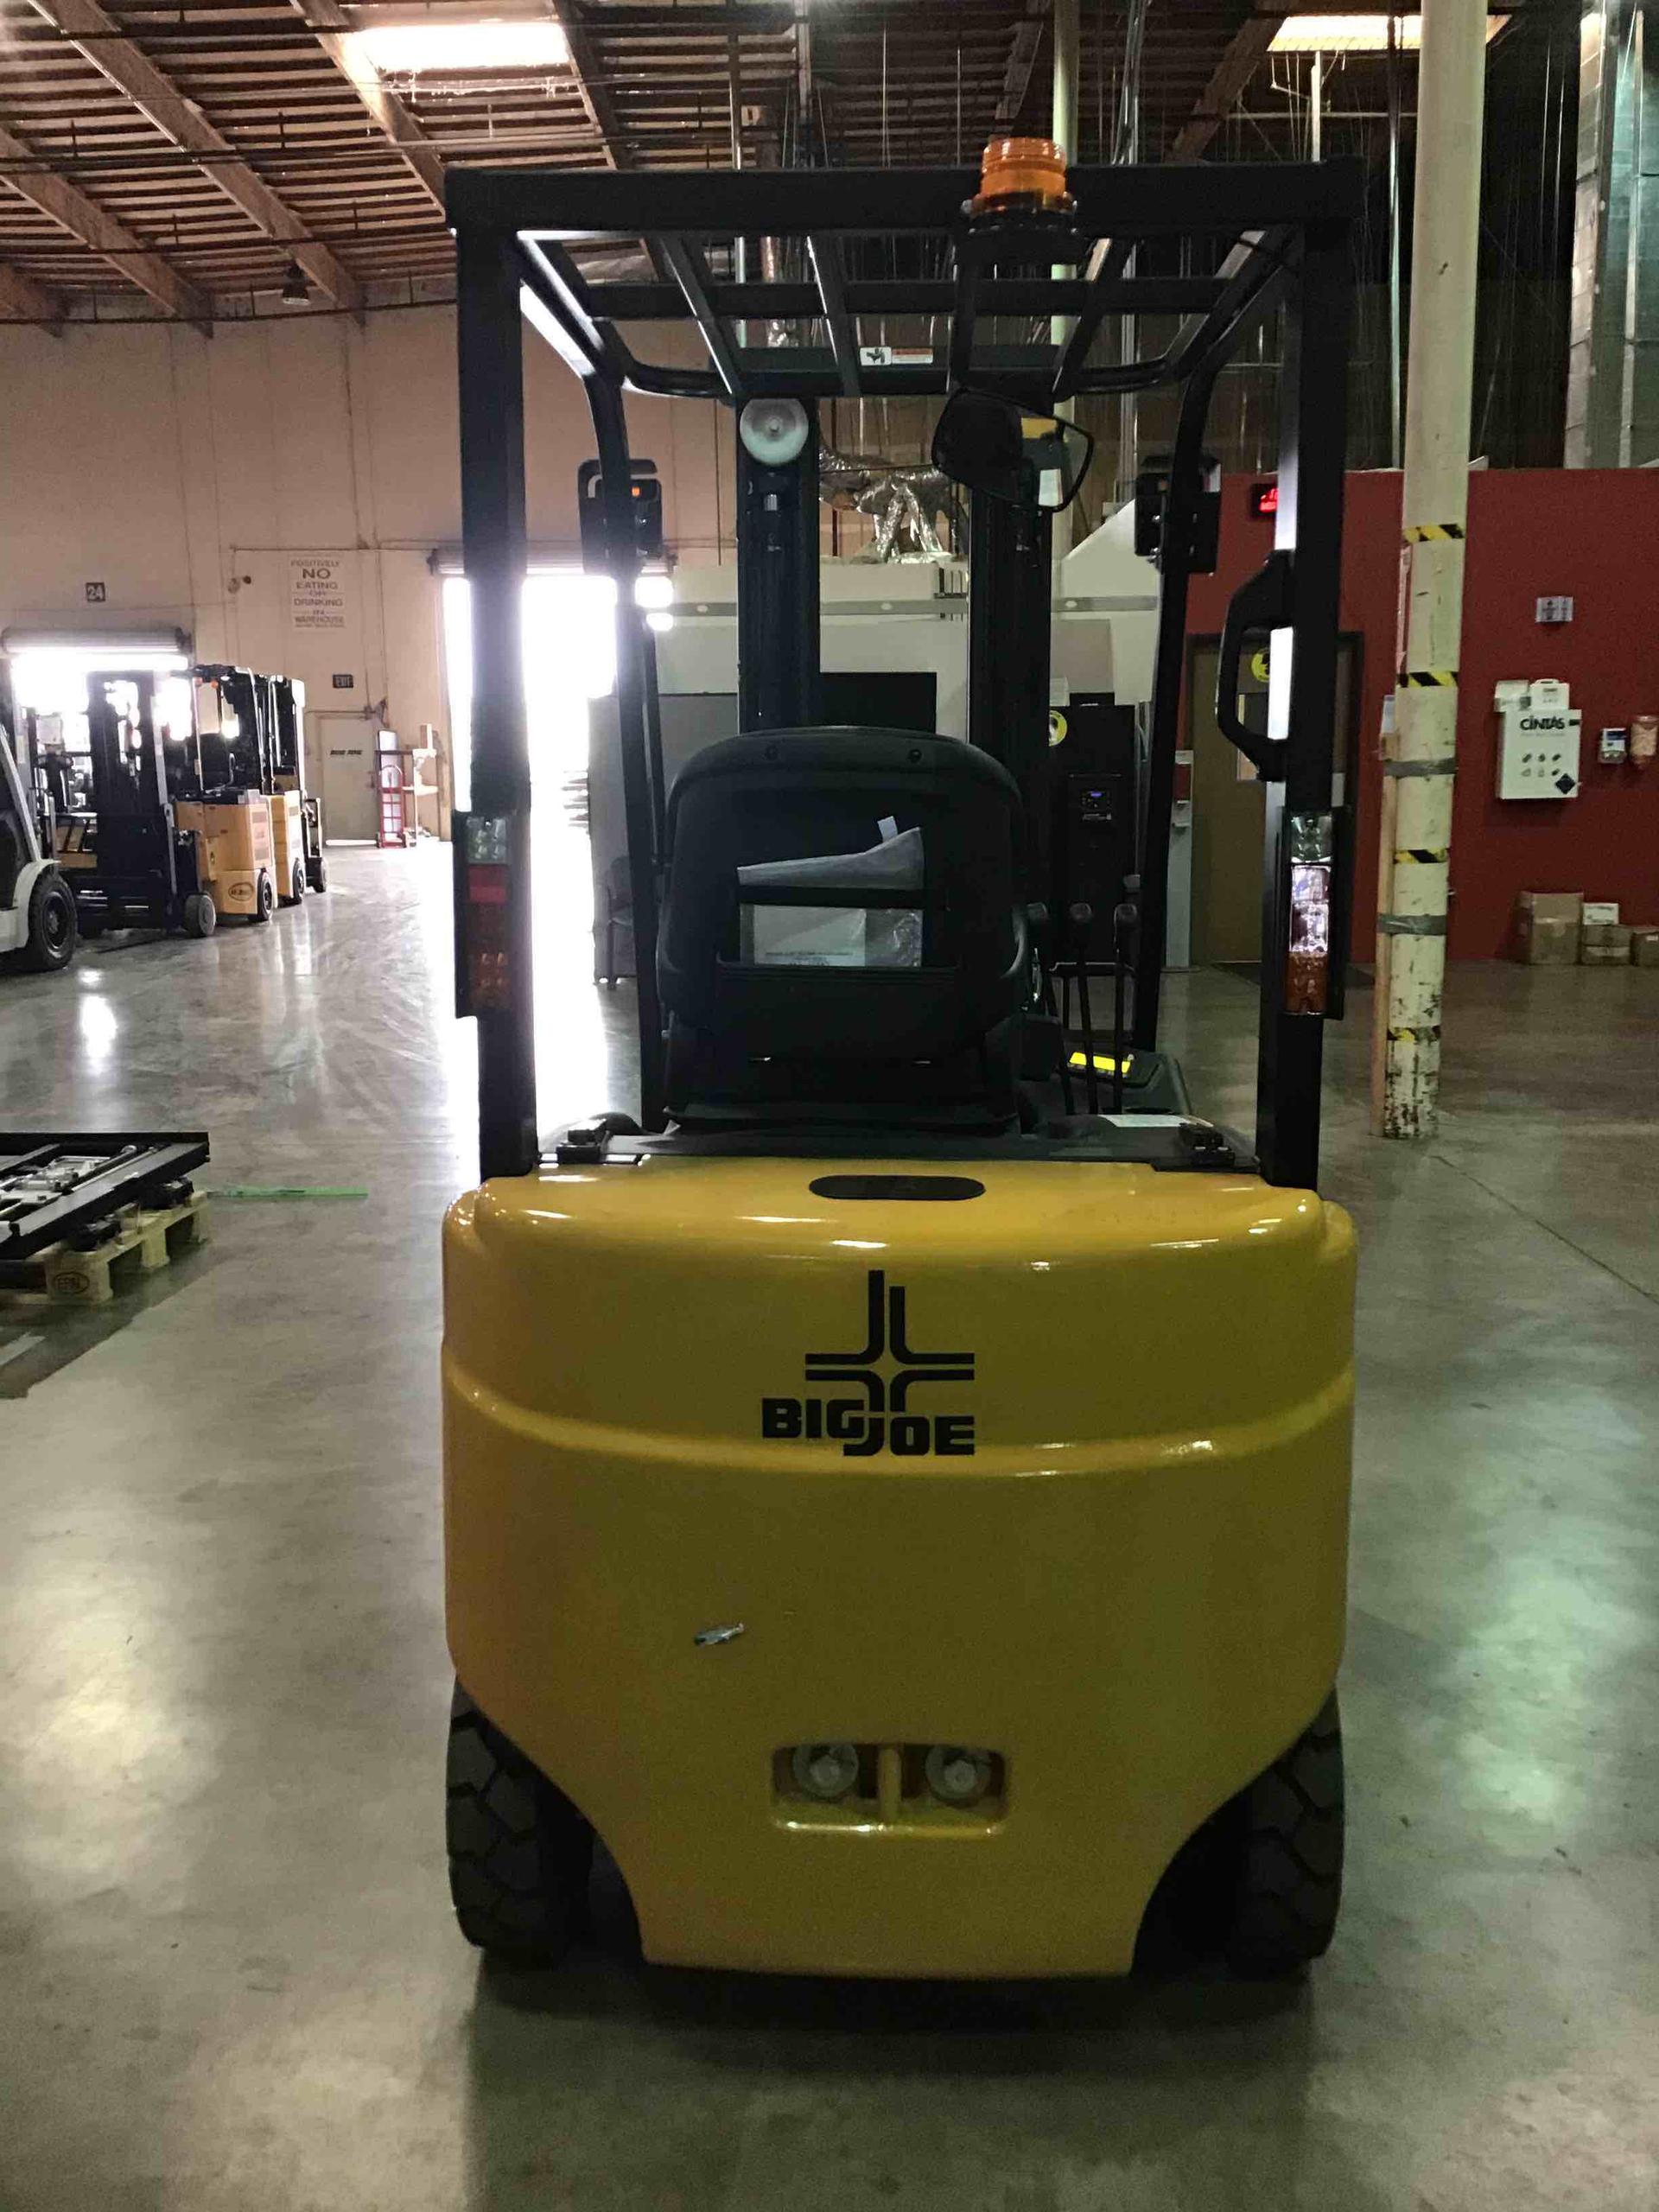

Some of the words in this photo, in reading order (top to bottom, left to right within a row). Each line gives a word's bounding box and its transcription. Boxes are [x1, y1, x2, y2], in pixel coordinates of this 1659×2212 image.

[302, 568, 331, 579] NO
[296, 581, 338, 589] EATING
[294, 598, 343, 607] DRINKING
[1520, 715, 1566, 731] CINTAS
[761, 1397, 866, 1439] BIG
[842, 1414, 976, 1457] JOE
